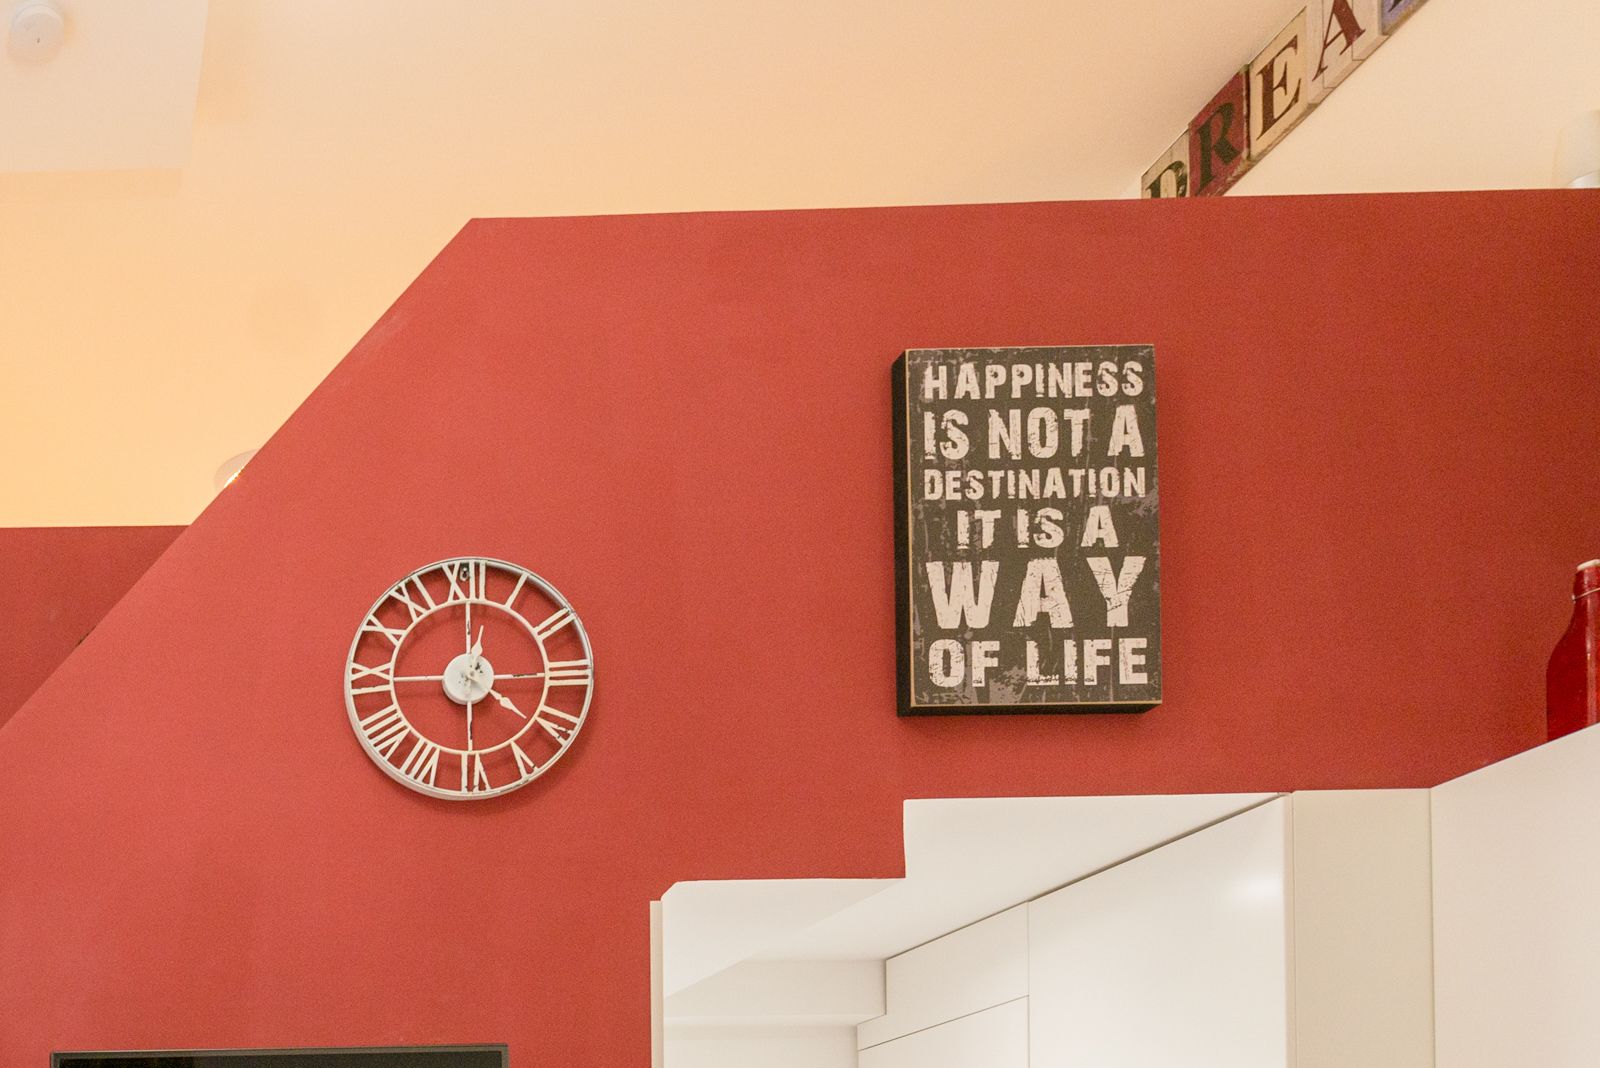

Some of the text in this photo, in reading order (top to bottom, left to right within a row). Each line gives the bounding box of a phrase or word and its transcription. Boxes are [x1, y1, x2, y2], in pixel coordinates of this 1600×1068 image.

[924, 361, 1144, 400] HAPPINESS
[924, 404, 1145, 460] IS NOT A
[924, 467, 1146, 500] DESTINATION
[957, 505, 1119, 549] IT IS A
[926, 556, 1147, 629] WAY
[928, 638, 1148, 688] OF LIFE
